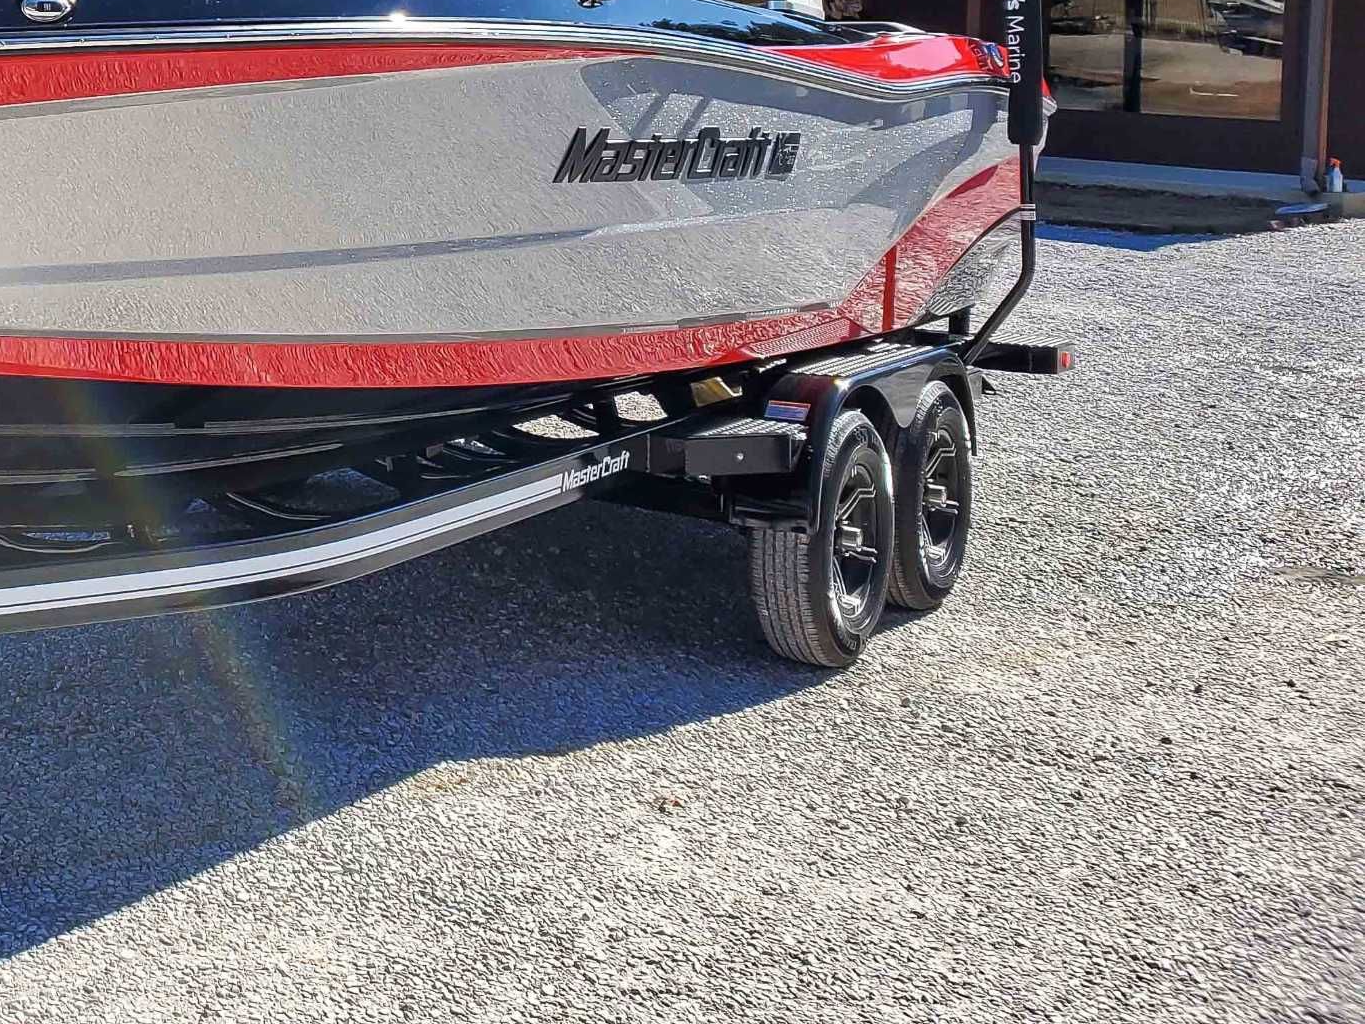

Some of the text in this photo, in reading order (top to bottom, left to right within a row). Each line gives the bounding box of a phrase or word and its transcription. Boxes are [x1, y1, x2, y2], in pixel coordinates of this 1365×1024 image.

[1005, 15, 1026, 84] Marine
[553, 126, 773, 183] MasterCraft
[562, 450, 631, 493] MasterCraft
